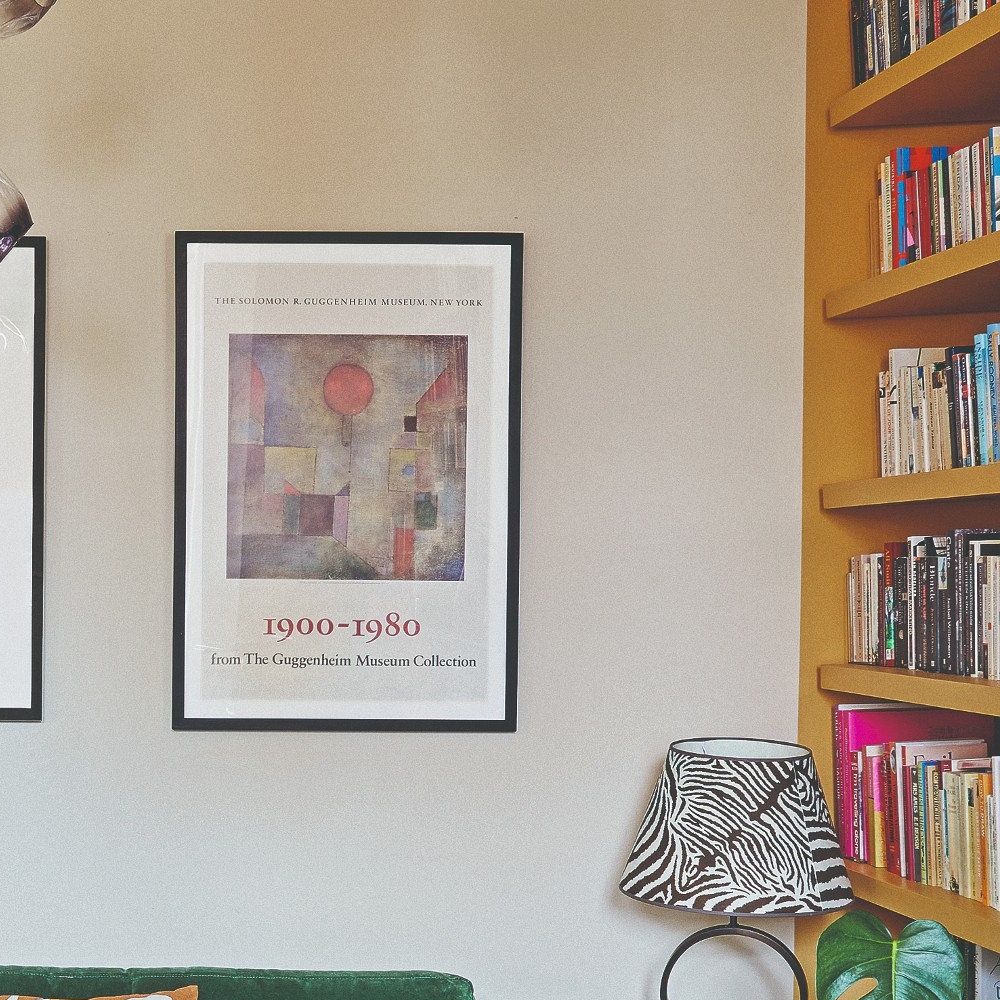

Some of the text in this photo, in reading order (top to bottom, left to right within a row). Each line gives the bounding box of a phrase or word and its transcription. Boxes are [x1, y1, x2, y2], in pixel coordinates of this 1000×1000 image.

[214, 297, 236, 305] THE
[238, 297, 290, 305] SOLOMON
[293, 297, 302, 305] R.
[303, 297, 378, 306] GUGGENHEIM
[430, 298, 455, 306] NEW
[455, 298, 483, 307] YORK
[988, 361, 996, 400] ROONEY
[263, 612, 421, 644] 1900-1980
[211, 652, 477, 669] from The Guggenheim Museum Collection
